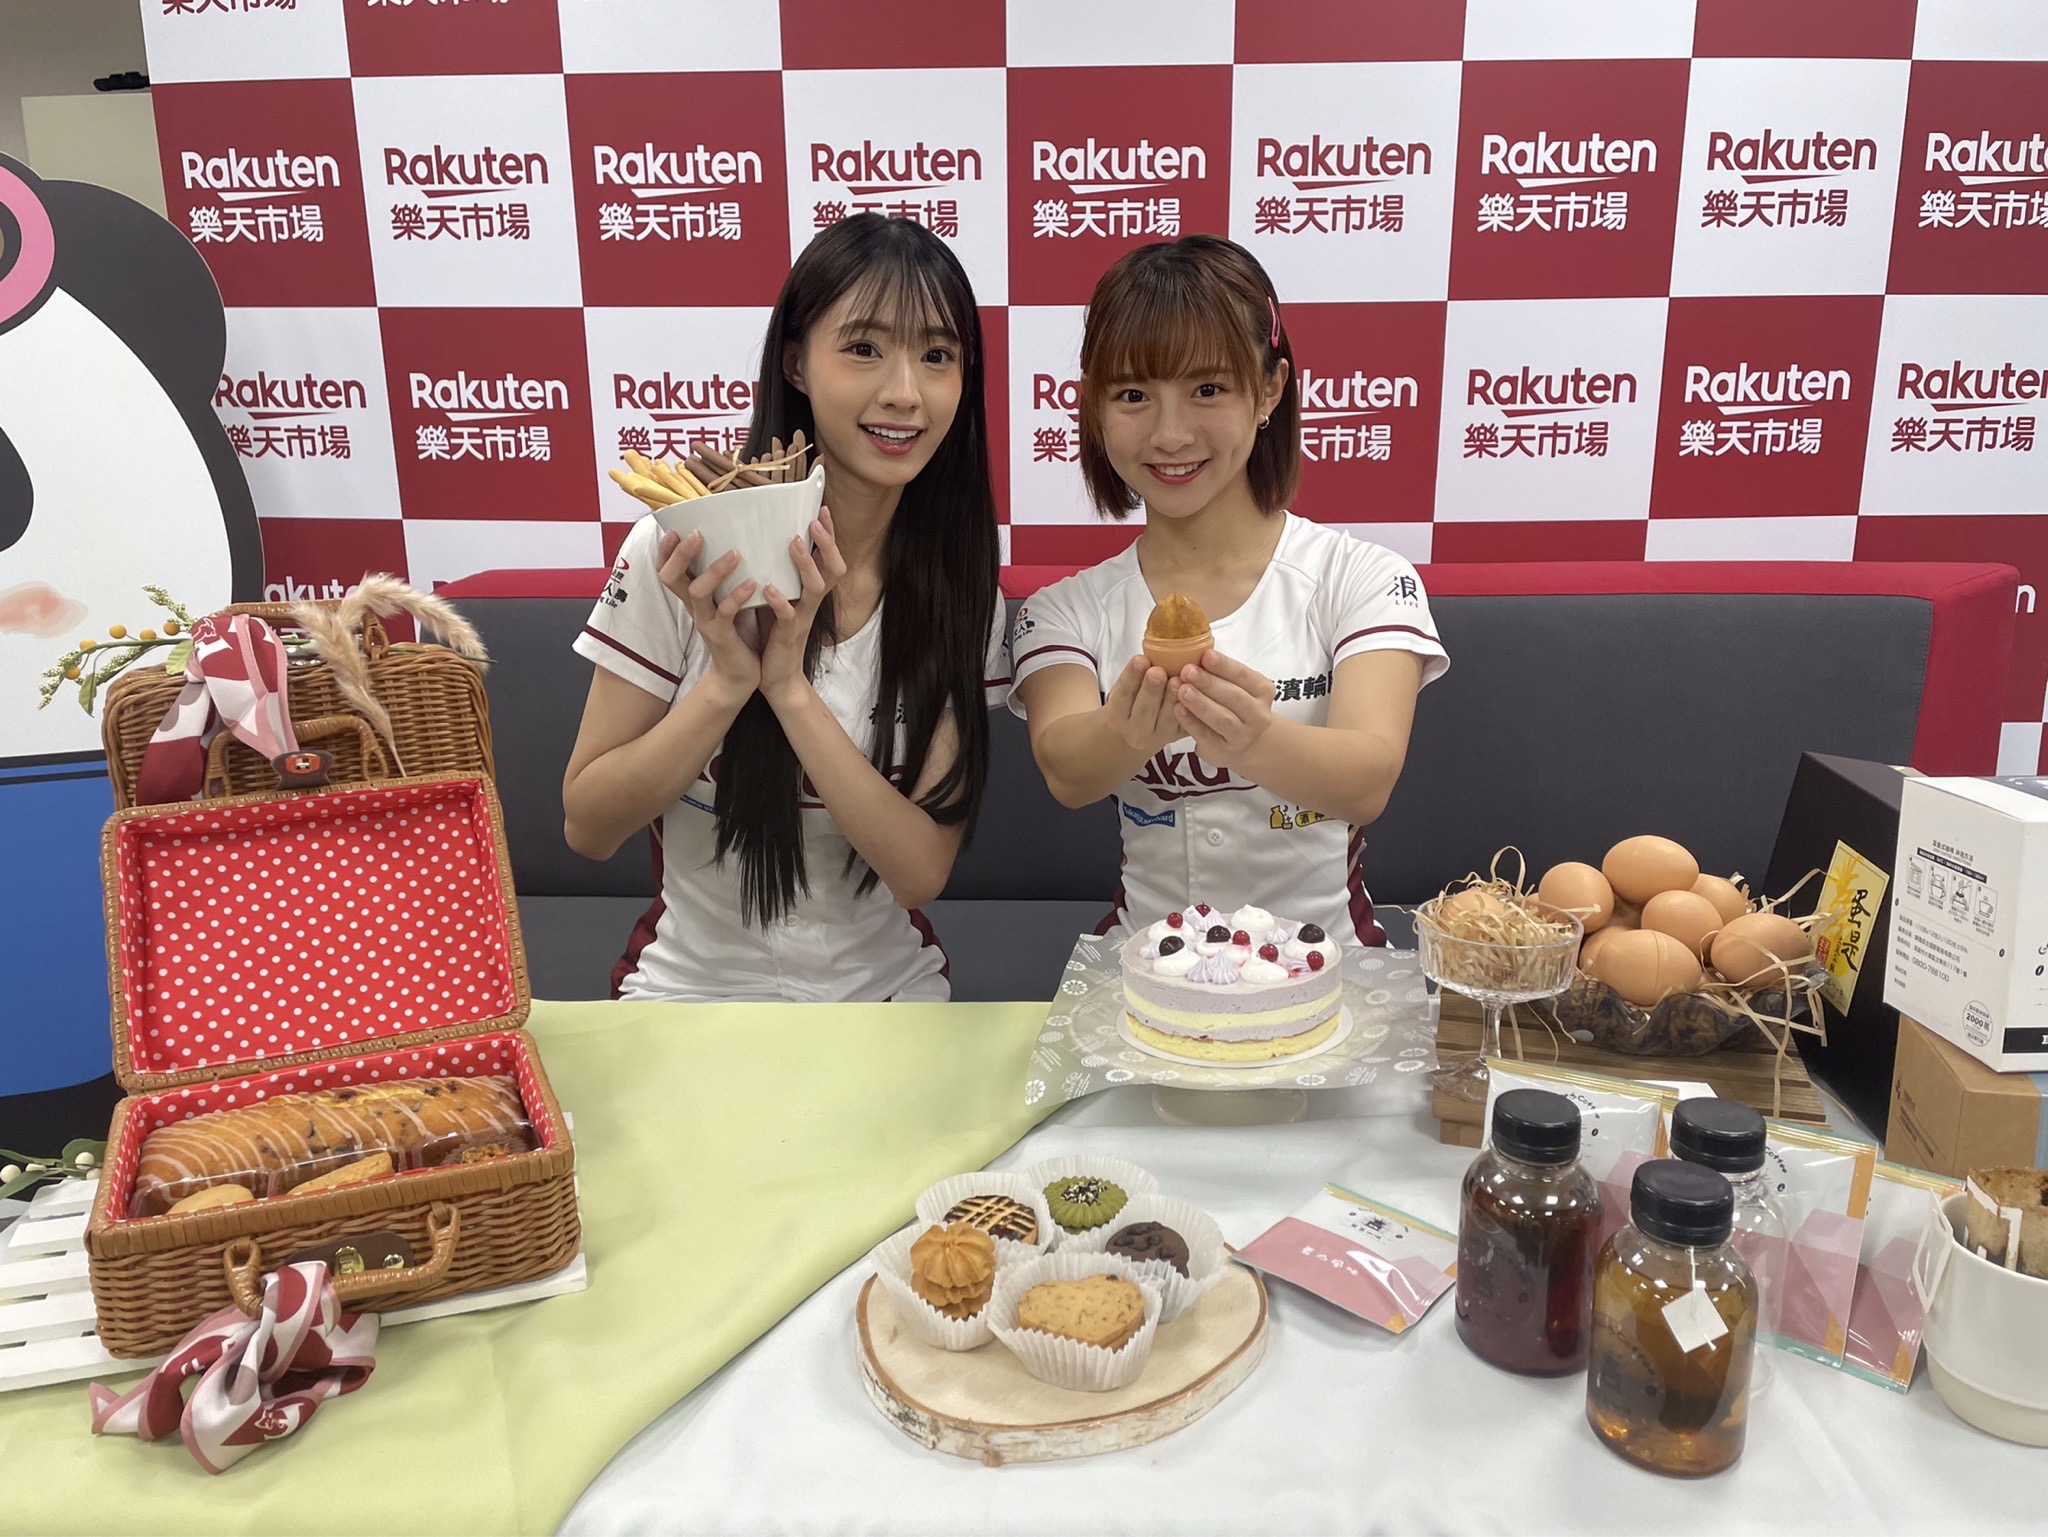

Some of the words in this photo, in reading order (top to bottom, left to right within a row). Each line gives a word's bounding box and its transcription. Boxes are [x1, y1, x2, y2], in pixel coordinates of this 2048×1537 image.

[182, 148, 340, 188] Rakuten
[385, 146, 548, 185] Rakuten
[594, 143, 762, 184] Rakuten
[812, 141, 981, 182] Rakuten
[1034, 138, 1205, 180] Rakuten
[1258, 136, 1431, 177] Rakuten
[1482, 132, 1656, 174] Rakuten
[1708, 129, 1876, 170] Rakuten
[1926, 131, 2048, 172] Rakut
[189, 205, 323, 244] 樂天市場
[392, 204, 529, 240] 樂天市場
[599, 202, 741, 241] 樂天市場
[1033, 198, 1180, 237] 樂天市場
[1256, 195, 1403, 234] 樂天市場
[1477, 192, 1627, 232] 樂天市場
[1700, 188, 1848, 228] 樂天市場
[215, 371, 367, 408] Rakuten
[410, 371, 568, 409] Rakuten
[614, 373, 757, 410] Rakute
[1297, 369, 1418, 408] kuten
[1468, 367, 1637, 405] Rakuten
[1685, 363, 1850, 402] Rakuten
[226, 425, 351, 459] 樂天市場
[416, 425, 550, 461] 樂天市場
[1300, 425, 1391, 461] 天市場
[1464, 422, 1609, 459] 樂天市場
[1679, 419, 1822, 456] 樂天市場
[1891, 416, 2035, 452] 樂天市場
[1387, 575, 1418, 601] 浪
[1272, 670, 1333, 701] 濱輪
